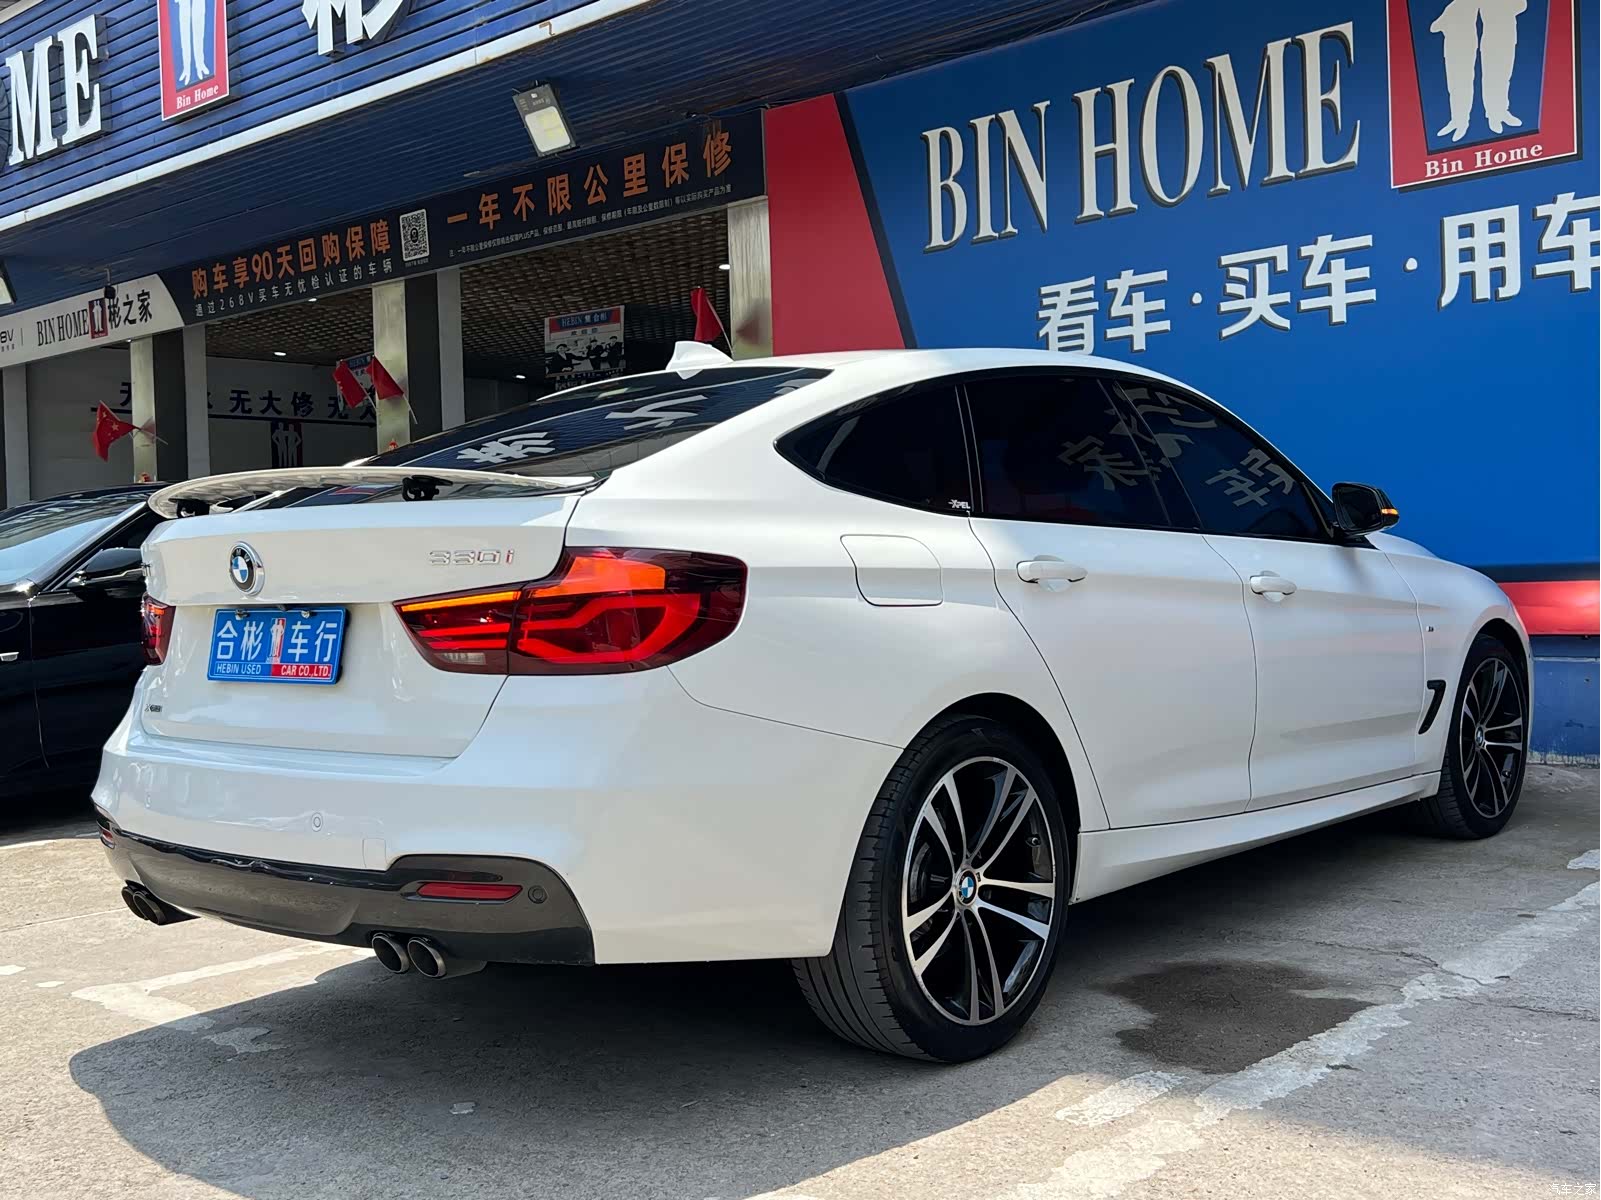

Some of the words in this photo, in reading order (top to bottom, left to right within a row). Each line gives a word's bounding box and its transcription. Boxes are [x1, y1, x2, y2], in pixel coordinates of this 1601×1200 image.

[176, 95, 191, 109] Bin
[194, 85, 219, 102] Home
[920, 100, 1050, 252] BIN
[1073, 21, 1361, 221] HOME
[1425, 159, 1464, 178] Bin
[1475, 144, 1543, 168] Home
[447, 131, 733, 230] 一年不限公里保修
[191, 219, 392, 299] 购车享90天回购保障
[37, 317, 56, 346] BIN
[57, 308, 89, 341] HOME
[229, 389, 314, 417] 无大修
[948, 499, 971, 509] XPEL
[429, 549, 514, 566] 330i
[217, 620, 265, 661] 合彬
[288, 620, 337, 662] 车行
[217, 664, 239, 674] HEBIN
[241, 665, 261, 675] USED
[281, 665, 297, 676] CAR
